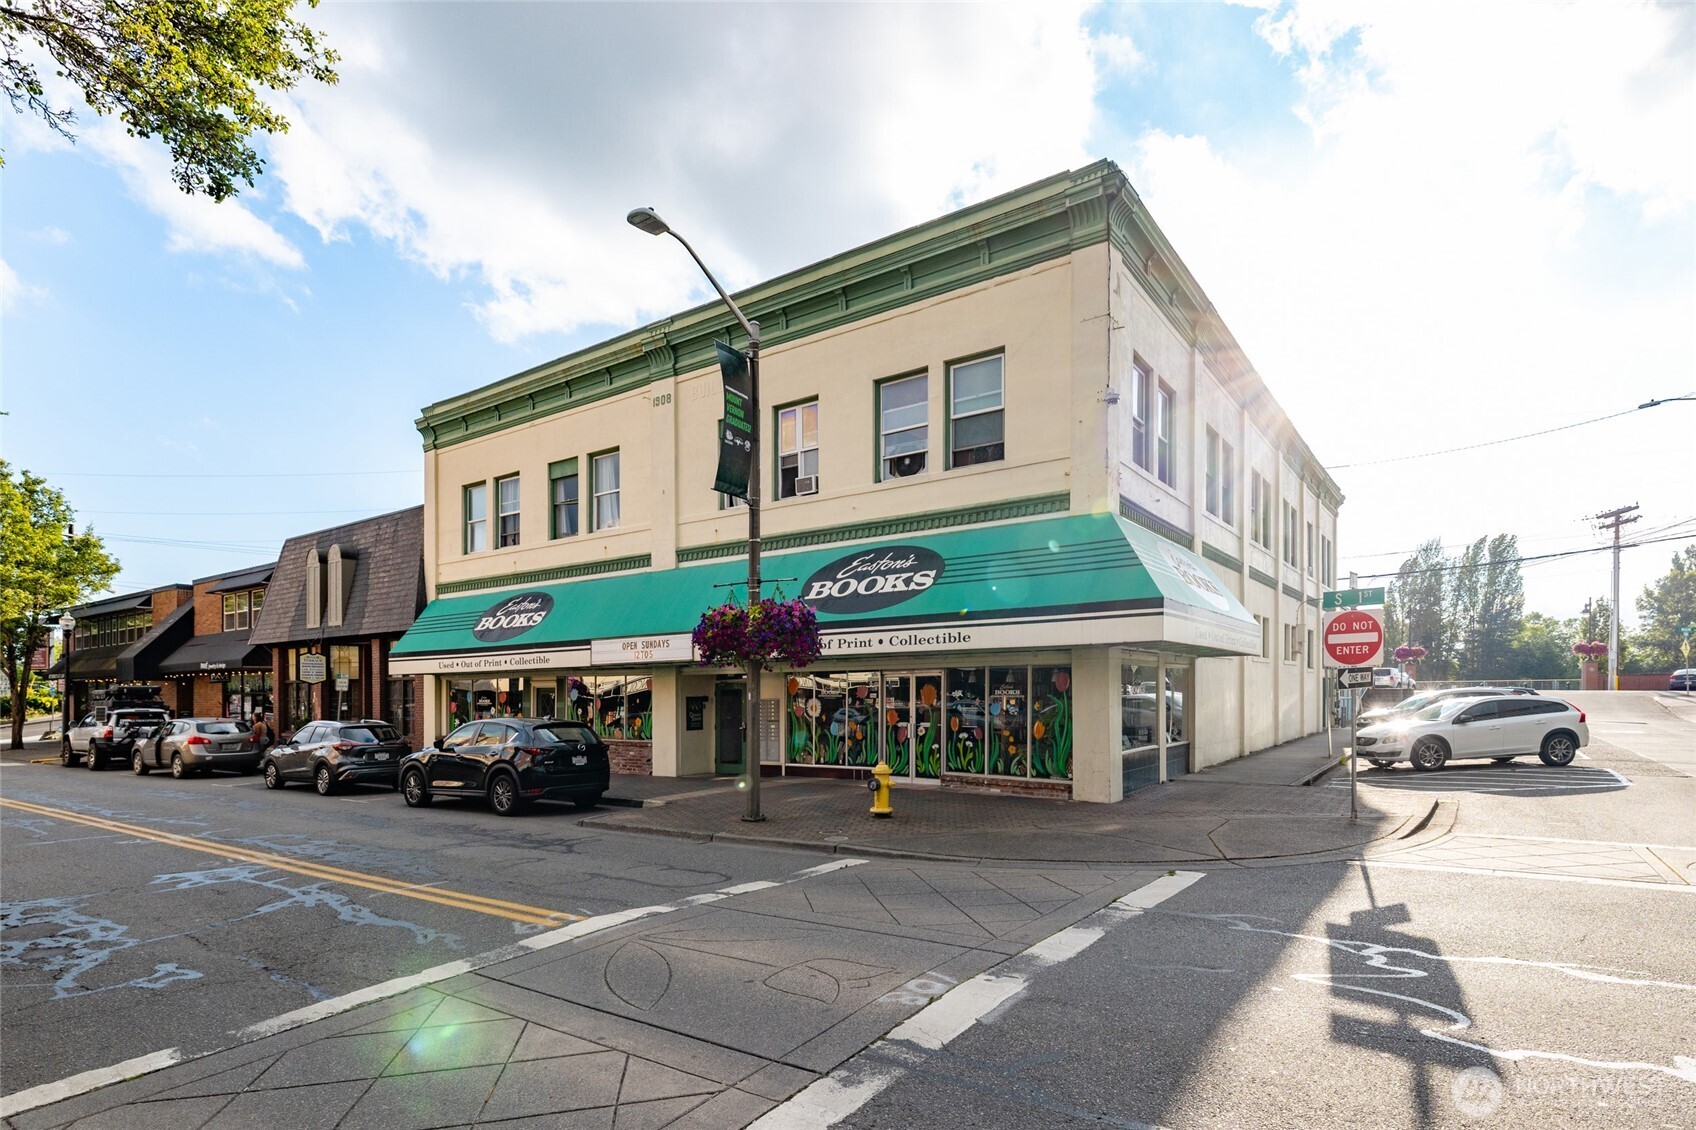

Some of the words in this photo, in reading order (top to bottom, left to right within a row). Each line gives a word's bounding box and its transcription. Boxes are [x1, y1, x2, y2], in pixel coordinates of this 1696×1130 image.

[653, 393, 672, 407] 1908
[836, 552, 918, 579] Easton's
[804, 570, 937, 600] BOOKS
[1334, 592, 1343, 605] S
[1358, 590, 1373, 604] 1ST
[474, 611, 547, 631] BOOKS
[1332, 622, 1347, 632] DO
[1352, 620, 1374, 631] NOT
[621, 641, 638, 651] OPEN
[641, 639, 670, 649] SUNDAYS
[838, 637, 874, 649] Print
[889, 631, 971, 647] Collectible
[1336, 645, 1369, 655] ENTER
[438, 661, 454, 670] Used
[460, 660, 474, 669] Out
[474, 661, 482, 669] of
[483, 659, 502, 668] Print
[509, 655, 551, 667] Collectible
[1348, 673, 1359, 682] ONE
[1360, 672, 1371, 682] WAY
